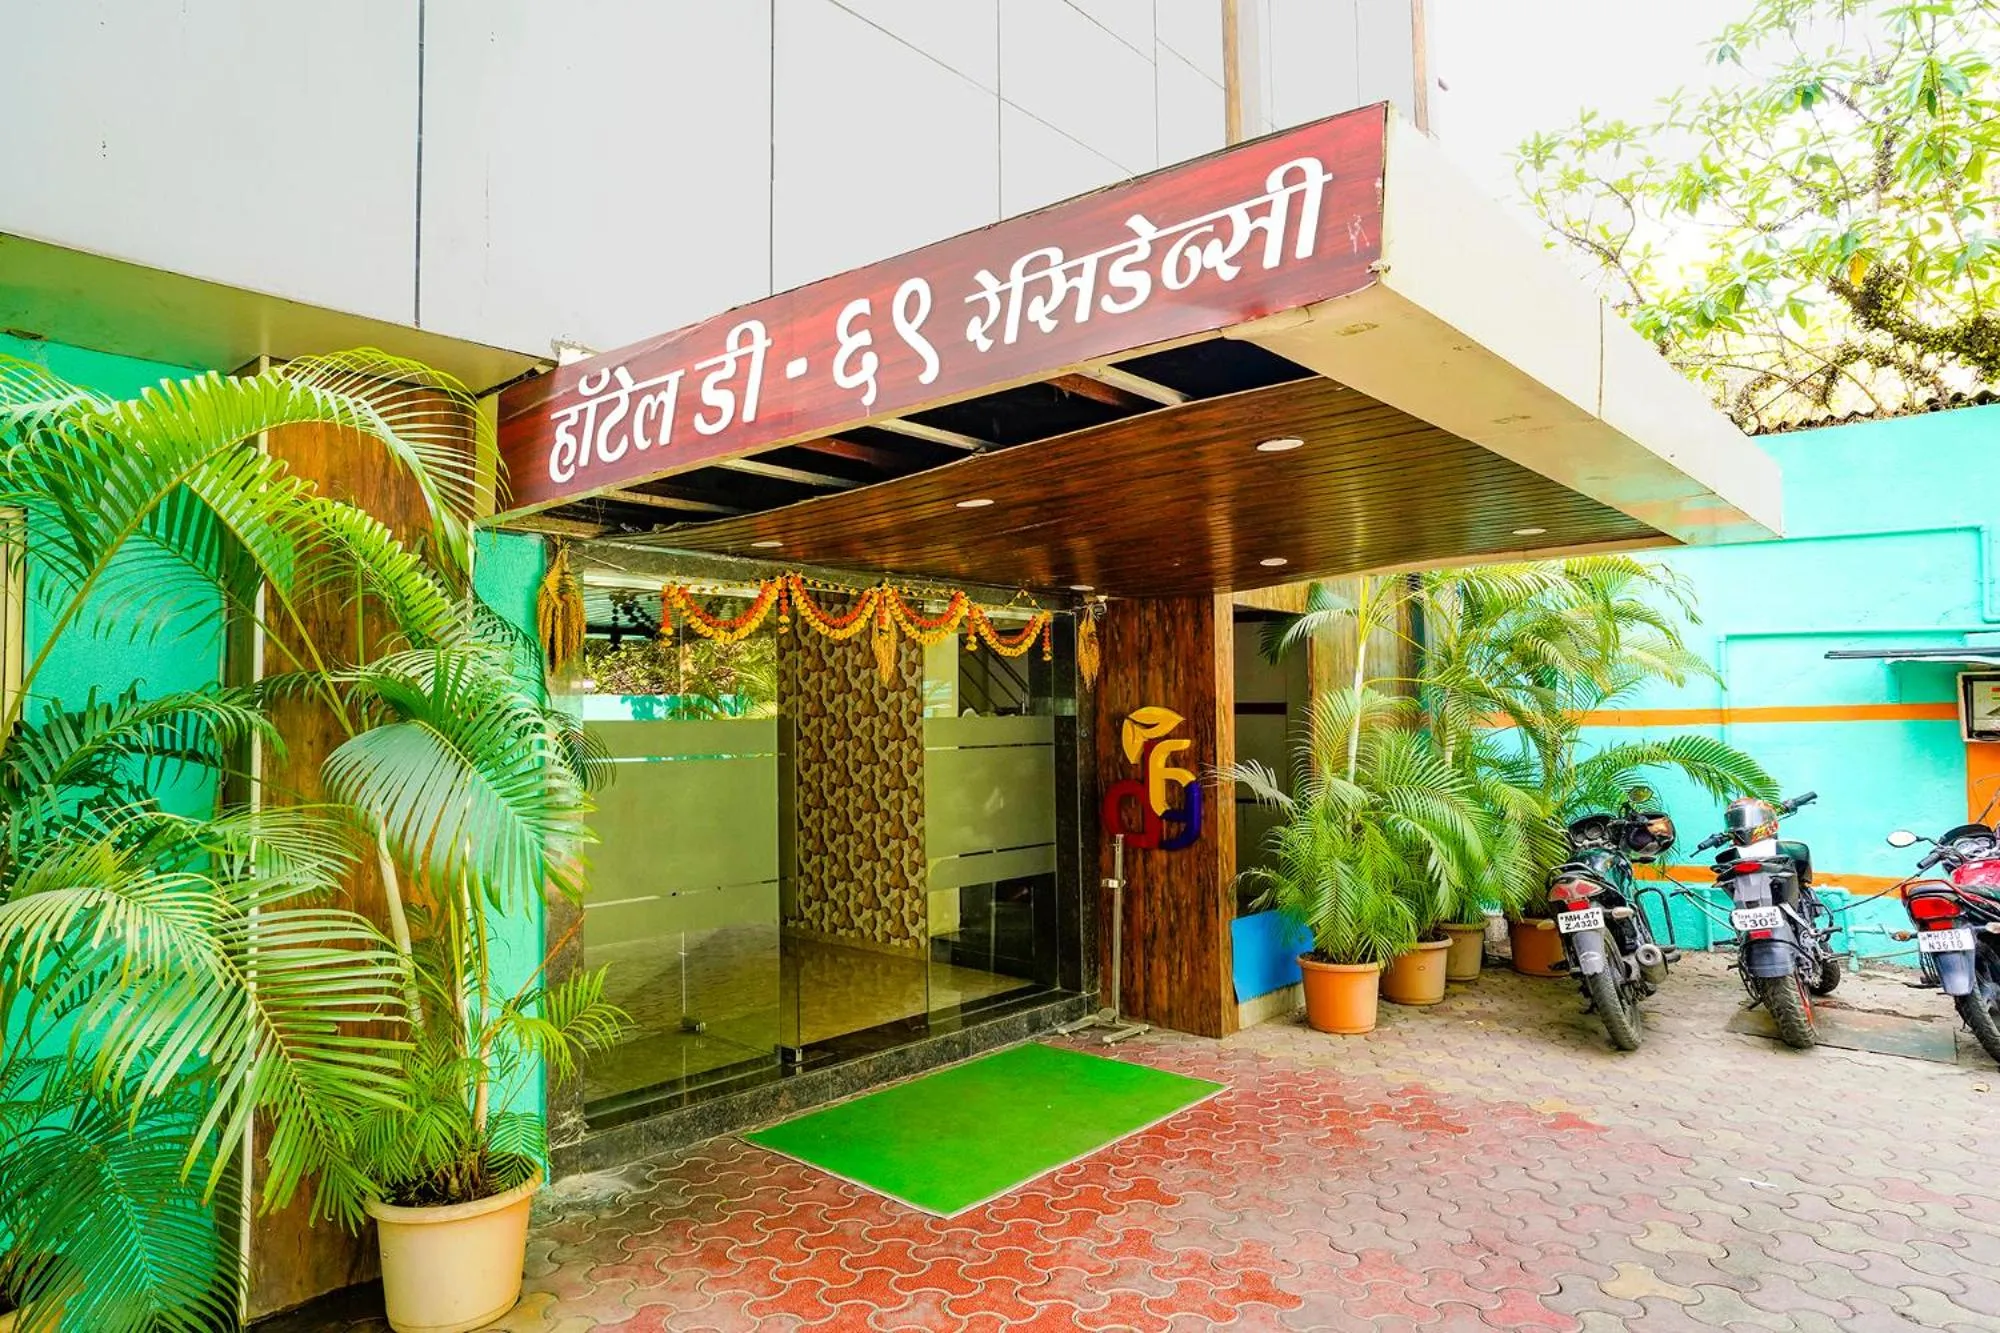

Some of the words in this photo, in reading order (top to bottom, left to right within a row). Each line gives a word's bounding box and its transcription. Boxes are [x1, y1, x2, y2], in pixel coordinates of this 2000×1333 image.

[549, 366, 686, 484] हॉटेल
[693, 319, 773, 436] डी
[832, 277, 941, 407] ६९
